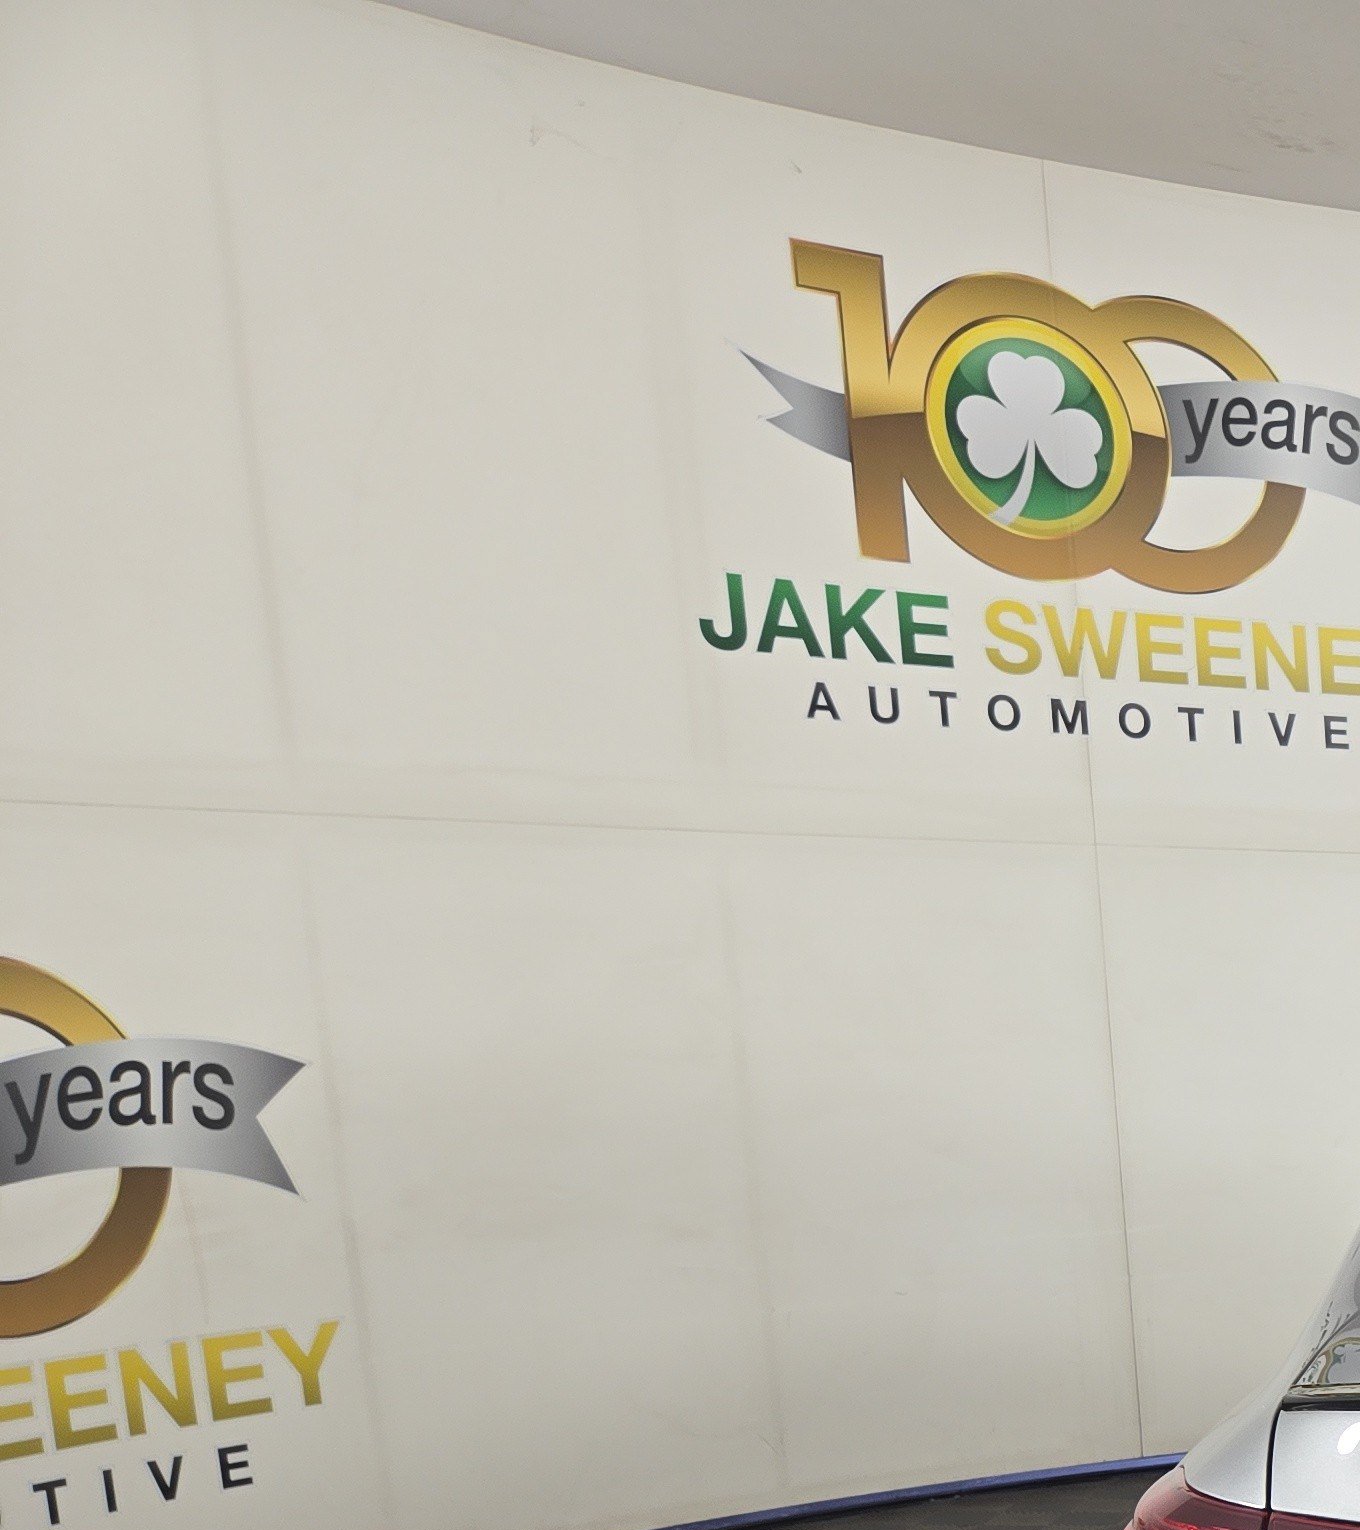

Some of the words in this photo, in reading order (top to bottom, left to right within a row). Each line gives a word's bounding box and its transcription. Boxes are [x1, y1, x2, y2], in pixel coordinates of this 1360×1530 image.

[790, 237, 1307, 594] 100
[1180, 397, 1360, 466] years
[698, 571, 954, 668] JAKE
[807, 682, 1350, 749] AUTOMOTIVE
[5, 1058, 235, 1165] years
